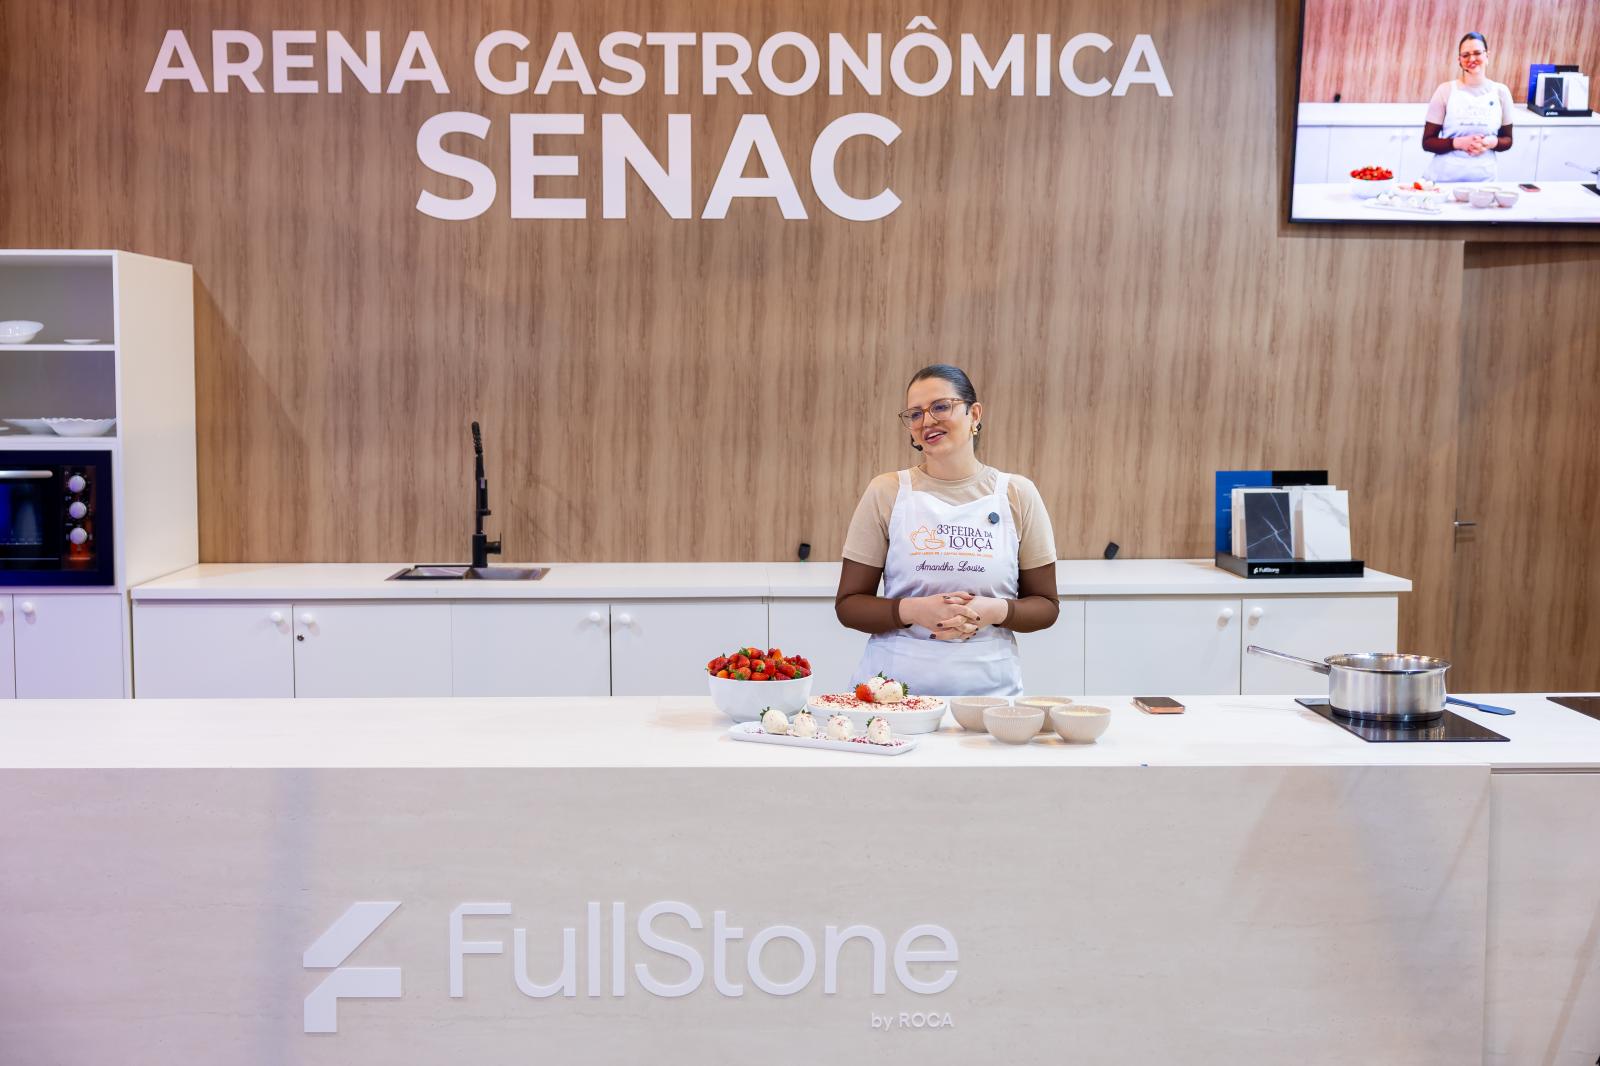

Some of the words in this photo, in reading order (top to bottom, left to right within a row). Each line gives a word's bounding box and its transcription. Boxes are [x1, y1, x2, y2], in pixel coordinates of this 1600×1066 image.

[145, 29, 450, 95] ARENA
[473, 14, 1175, 98] GASTRONÔMICA
[414, 110, 903, 222] SENAC
[915, 559, 954, 572] Amandha
[957, 560, 985, 572] Louise
[949, 535, 993, 551] LOUÇA
[448, 900, 960, 999] FullStone
[871, 1012, 893, 1032] by
[899, 1012, 954, 1028] ROCA
